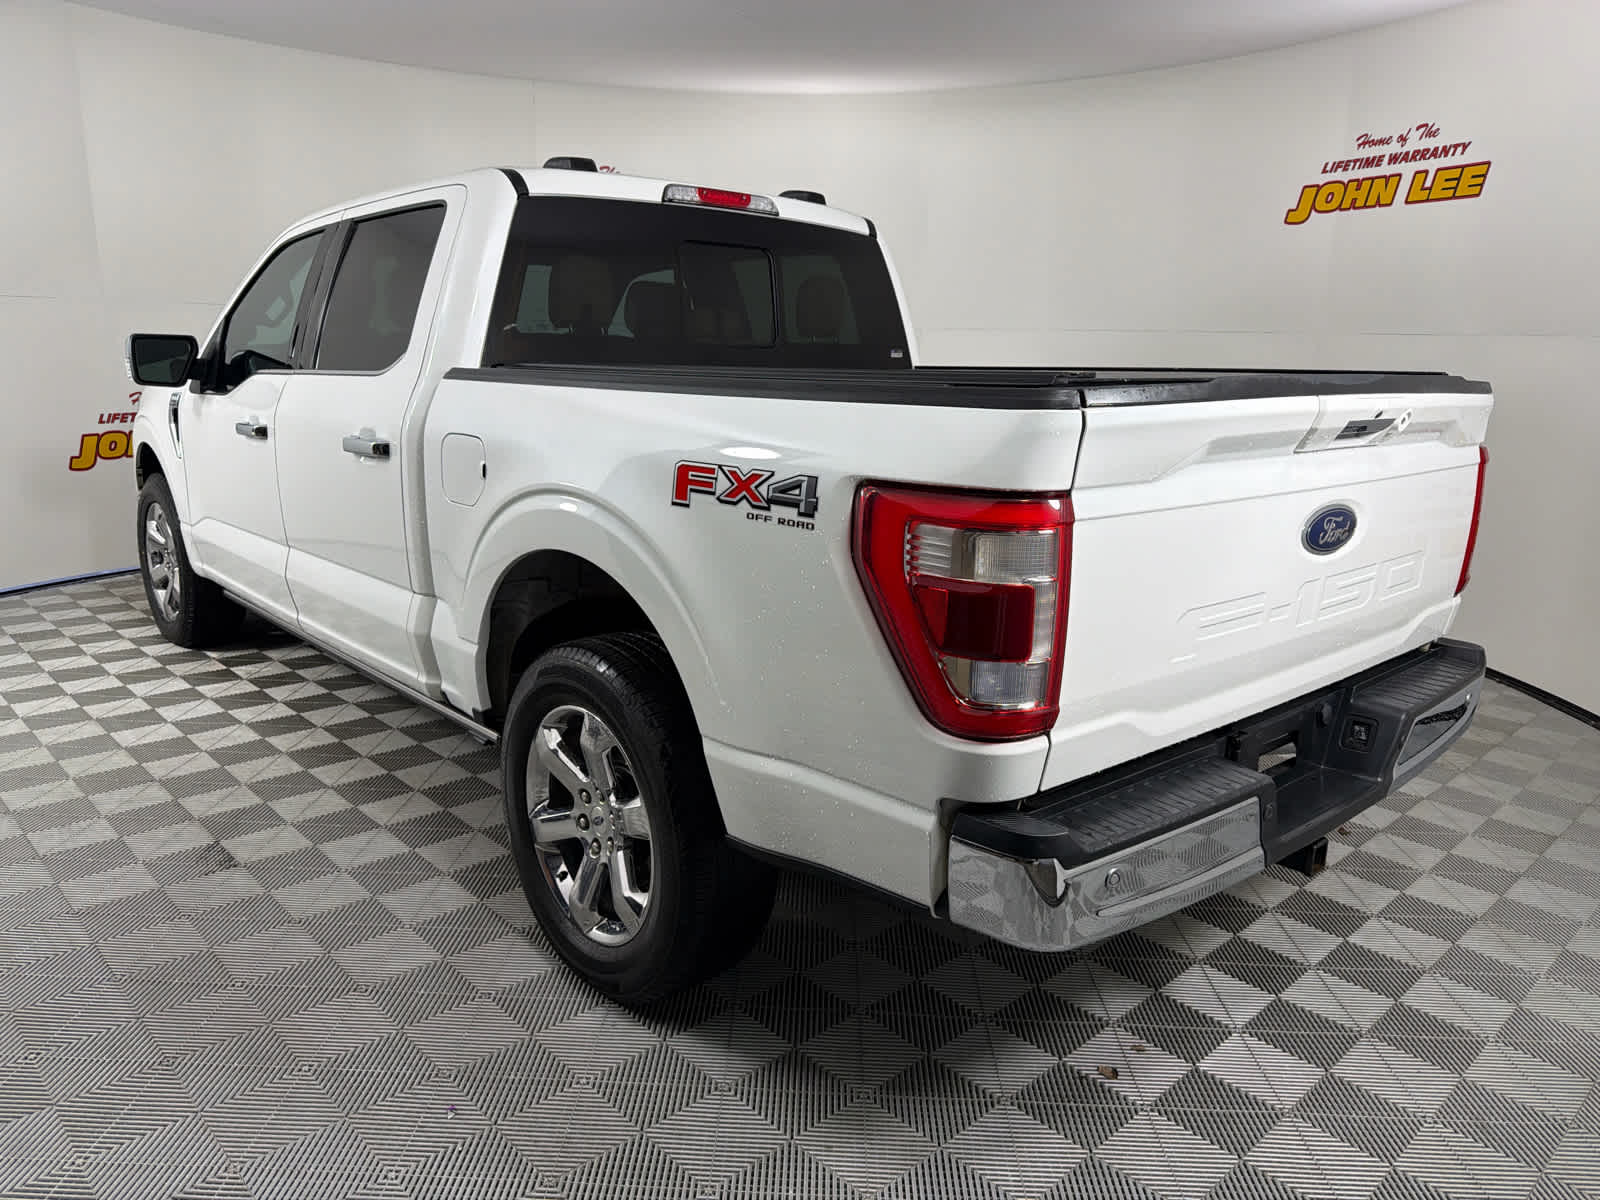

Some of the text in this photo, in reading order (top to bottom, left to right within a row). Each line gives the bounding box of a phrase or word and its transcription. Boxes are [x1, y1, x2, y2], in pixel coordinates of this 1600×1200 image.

[1356, 122, 1441, 150] Home of The
[1321, 141, 1472, 174] LIFETIME WARRANTY
[1284, 160, 1492, 225] JOHN LEE
[98, 412, 138, 424] LIFET
[69, 429, 134, 471] JO
[671, 459, 819, 519] FX4
[746, 512, 816, 531] OFF ROAD
[1319, 516, 1350, 545] Ford
[1168, 549, 1425, 664] F-150
